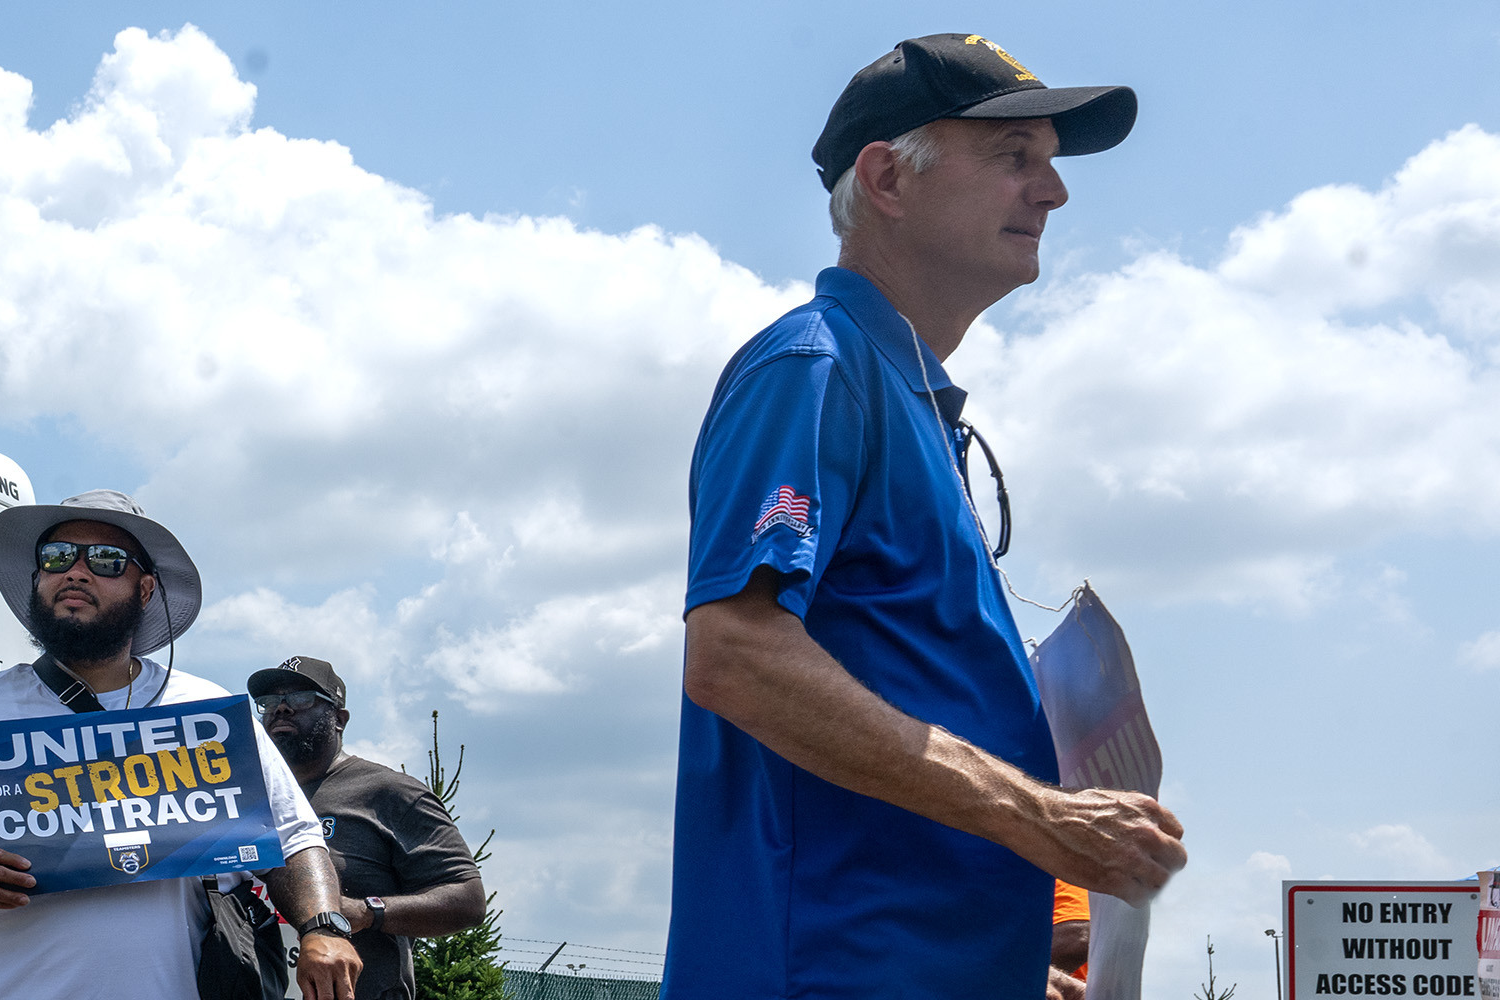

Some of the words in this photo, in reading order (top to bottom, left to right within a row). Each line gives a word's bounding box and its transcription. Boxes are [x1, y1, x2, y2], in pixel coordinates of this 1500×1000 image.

[13, 783, 23, 796] A
[24, 740, 232, 813] STRONG
[1342, 902, 1373, 923] NO
[1380, 902, 1453, 924] ENTRY
[1342, 938, 1453, 960] WITHOUT
[1316, 973, 1407, 995] ACCESS
[1413, 975, 1475, 996] CODE
